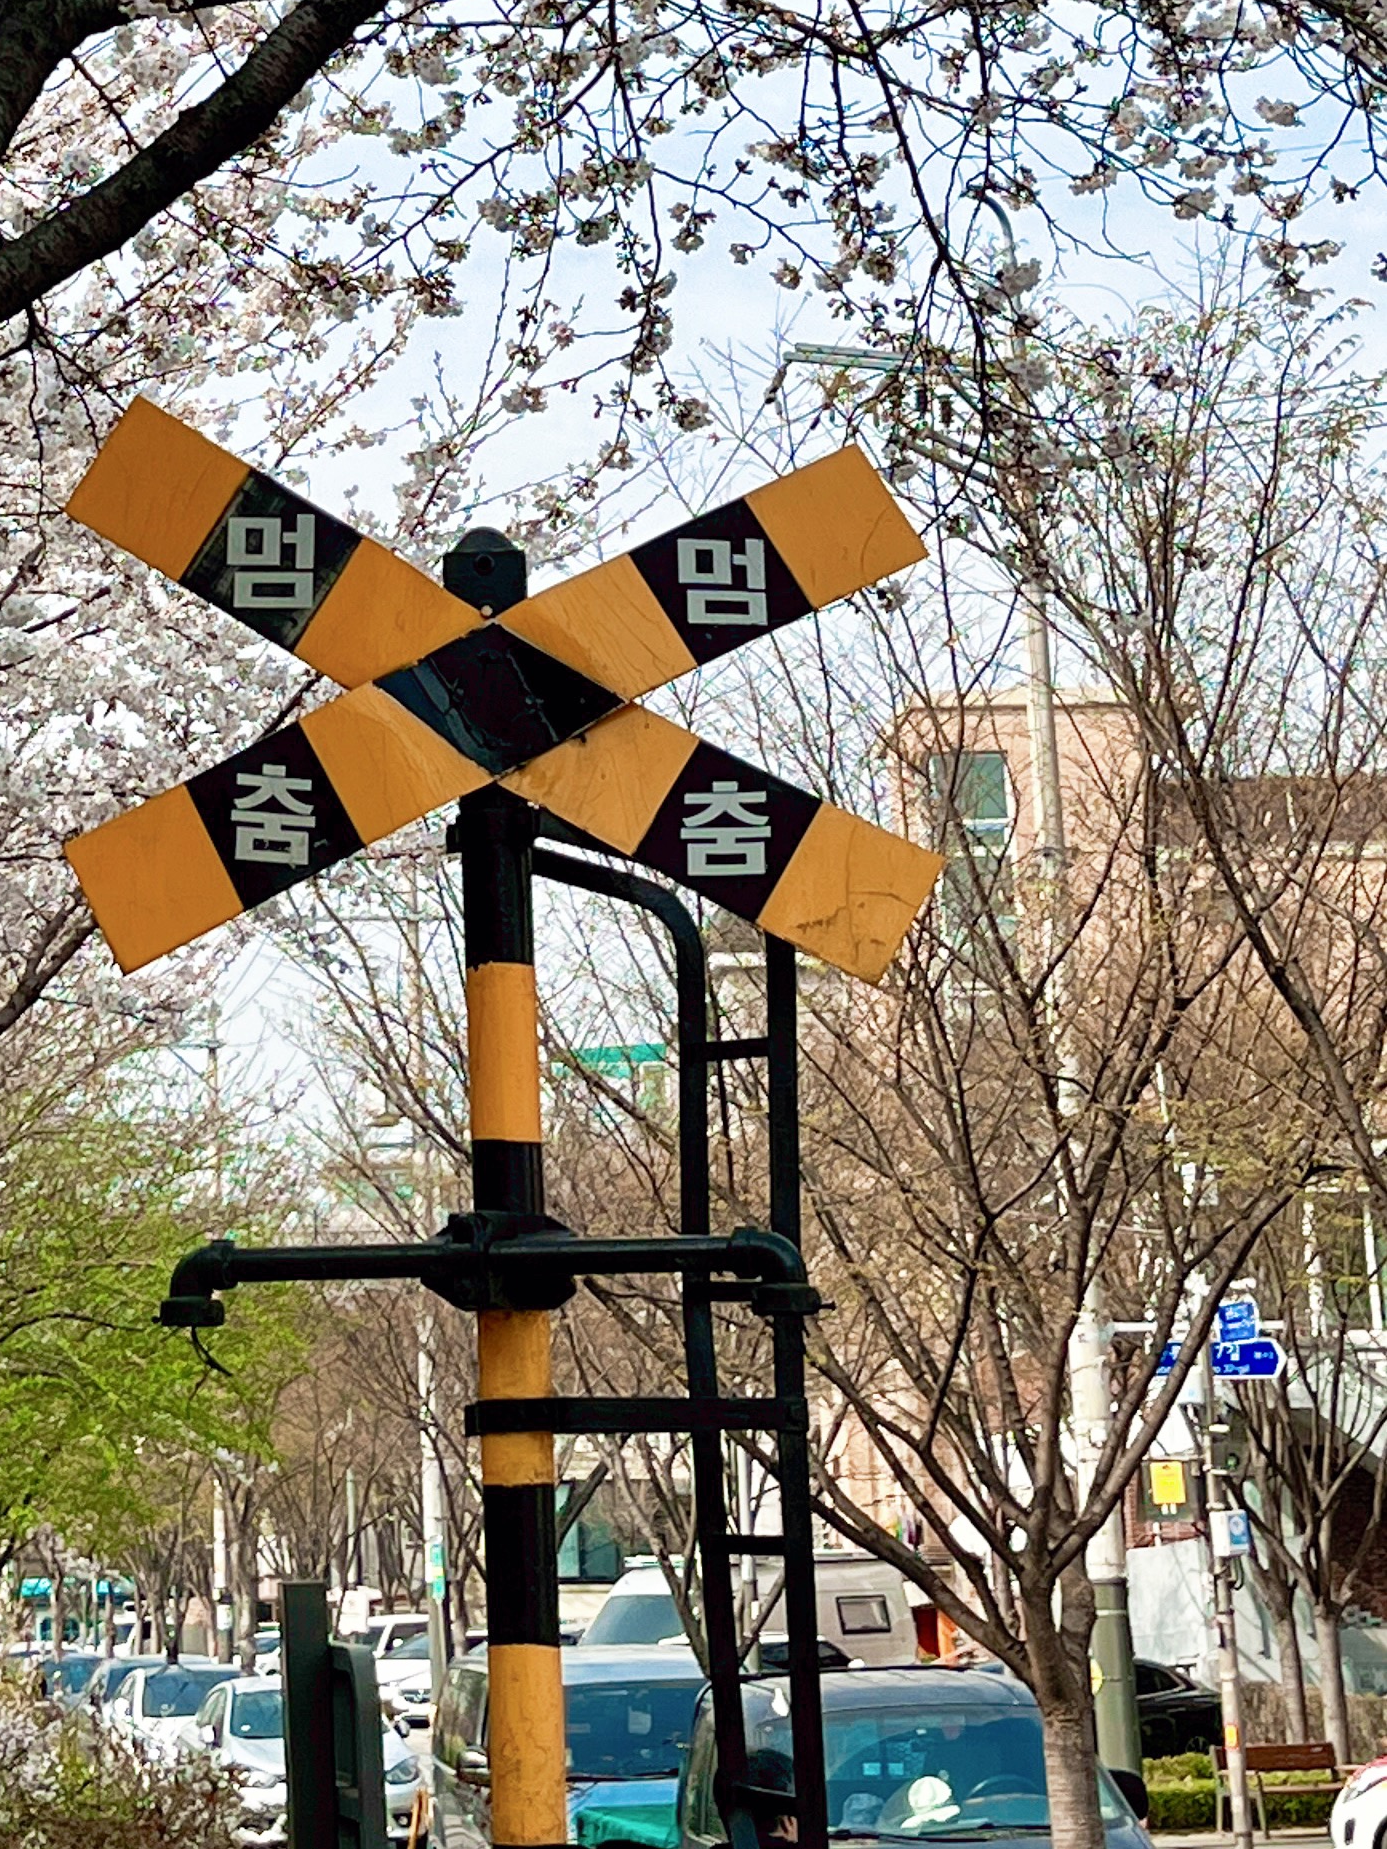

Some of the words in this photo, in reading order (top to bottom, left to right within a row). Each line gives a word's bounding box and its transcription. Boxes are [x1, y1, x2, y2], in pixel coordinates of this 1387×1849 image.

[226, 513, 315, 609] 멈
[676, 537, 768, 627] 멈
[231, 763, 316, 866] 춤
[680, 780, 772, 877] 춤
